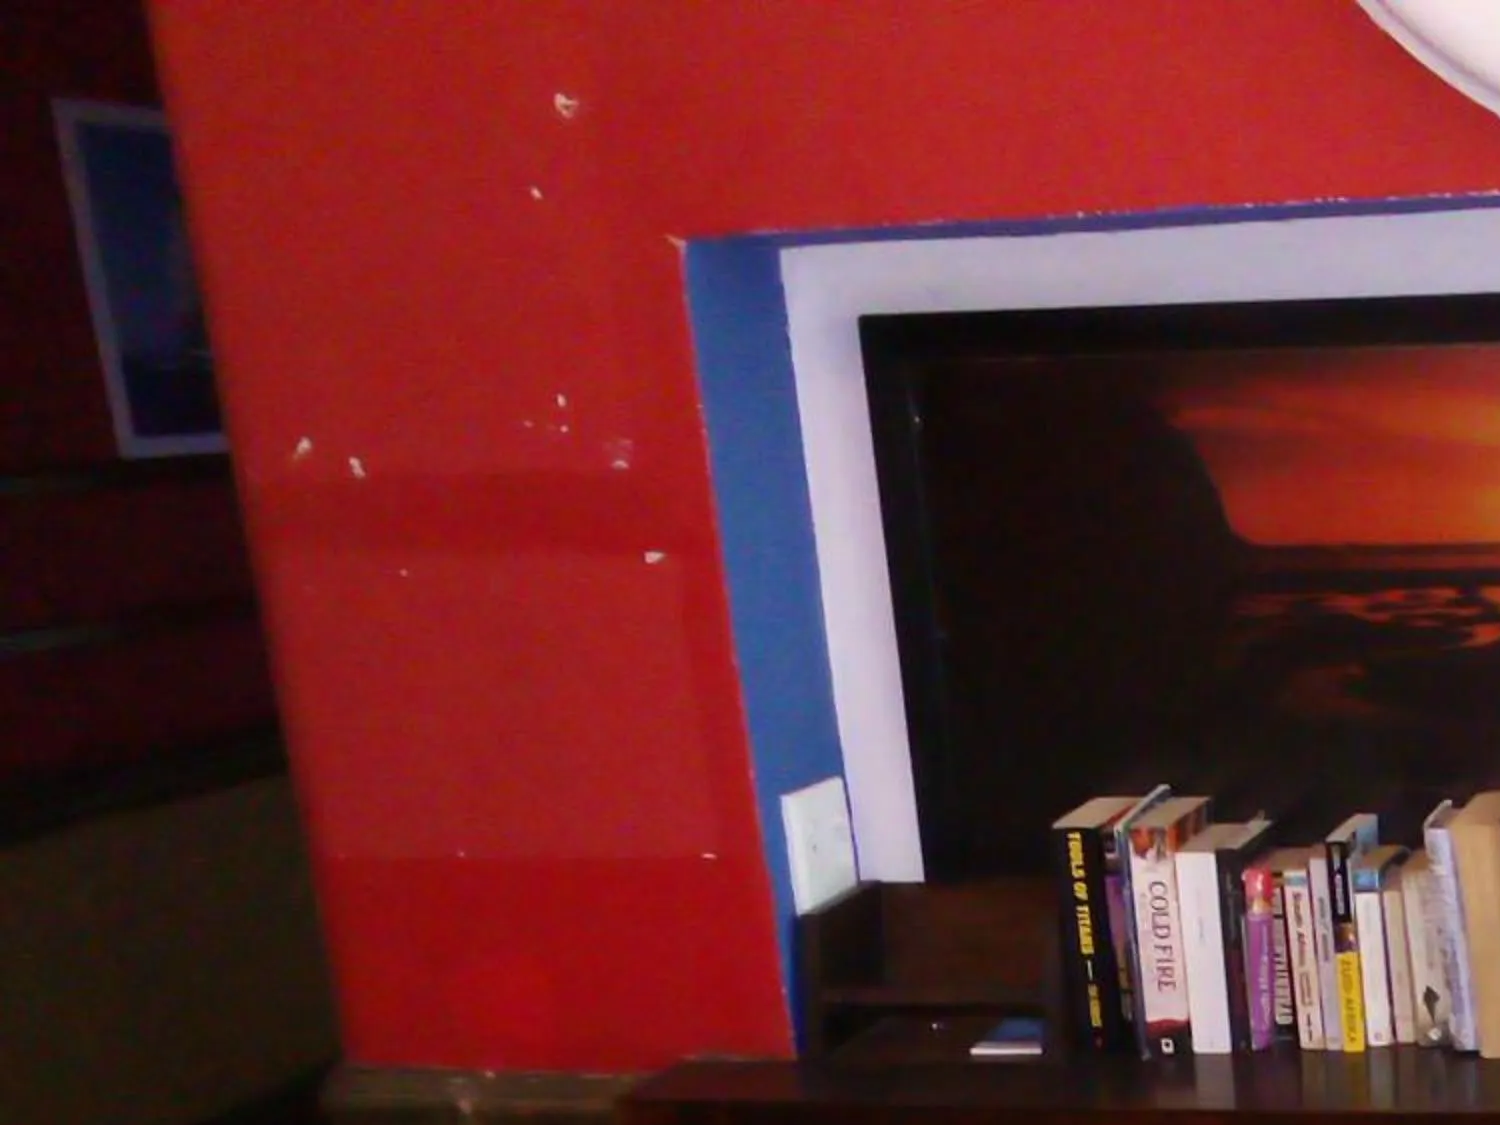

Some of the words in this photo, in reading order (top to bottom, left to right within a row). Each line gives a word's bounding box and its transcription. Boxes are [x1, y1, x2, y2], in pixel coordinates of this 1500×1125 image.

[1066, 831, 1085, 878] TOOLS
[1074, 881, 1089, 900] OF
[1149, 880, 1171, 940] COLD
[1075, 905, 1095, 955] TITANS
[1153, 944, 1177, 993] FIRE
